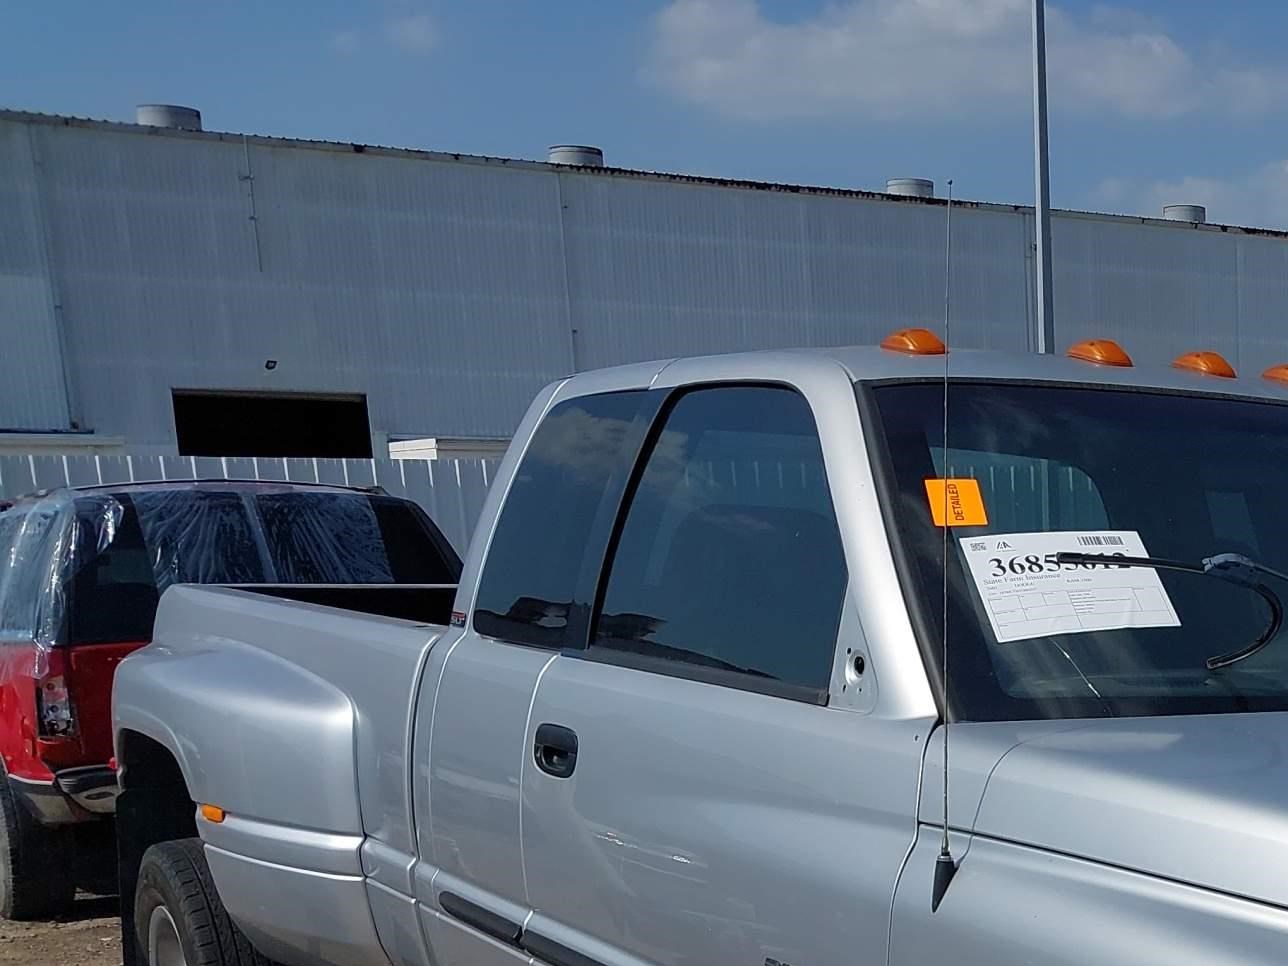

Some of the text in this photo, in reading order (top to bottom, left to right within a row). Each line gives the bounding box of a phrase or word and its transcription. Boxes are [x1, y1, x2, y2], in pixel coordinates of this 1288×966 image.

[947, 483, 965, 521] DETAILED
[983, 577, 1003, 585] State
[1004, 575, 1025, 583] Farm
[1025, 573, 1061, 581] Insurance
